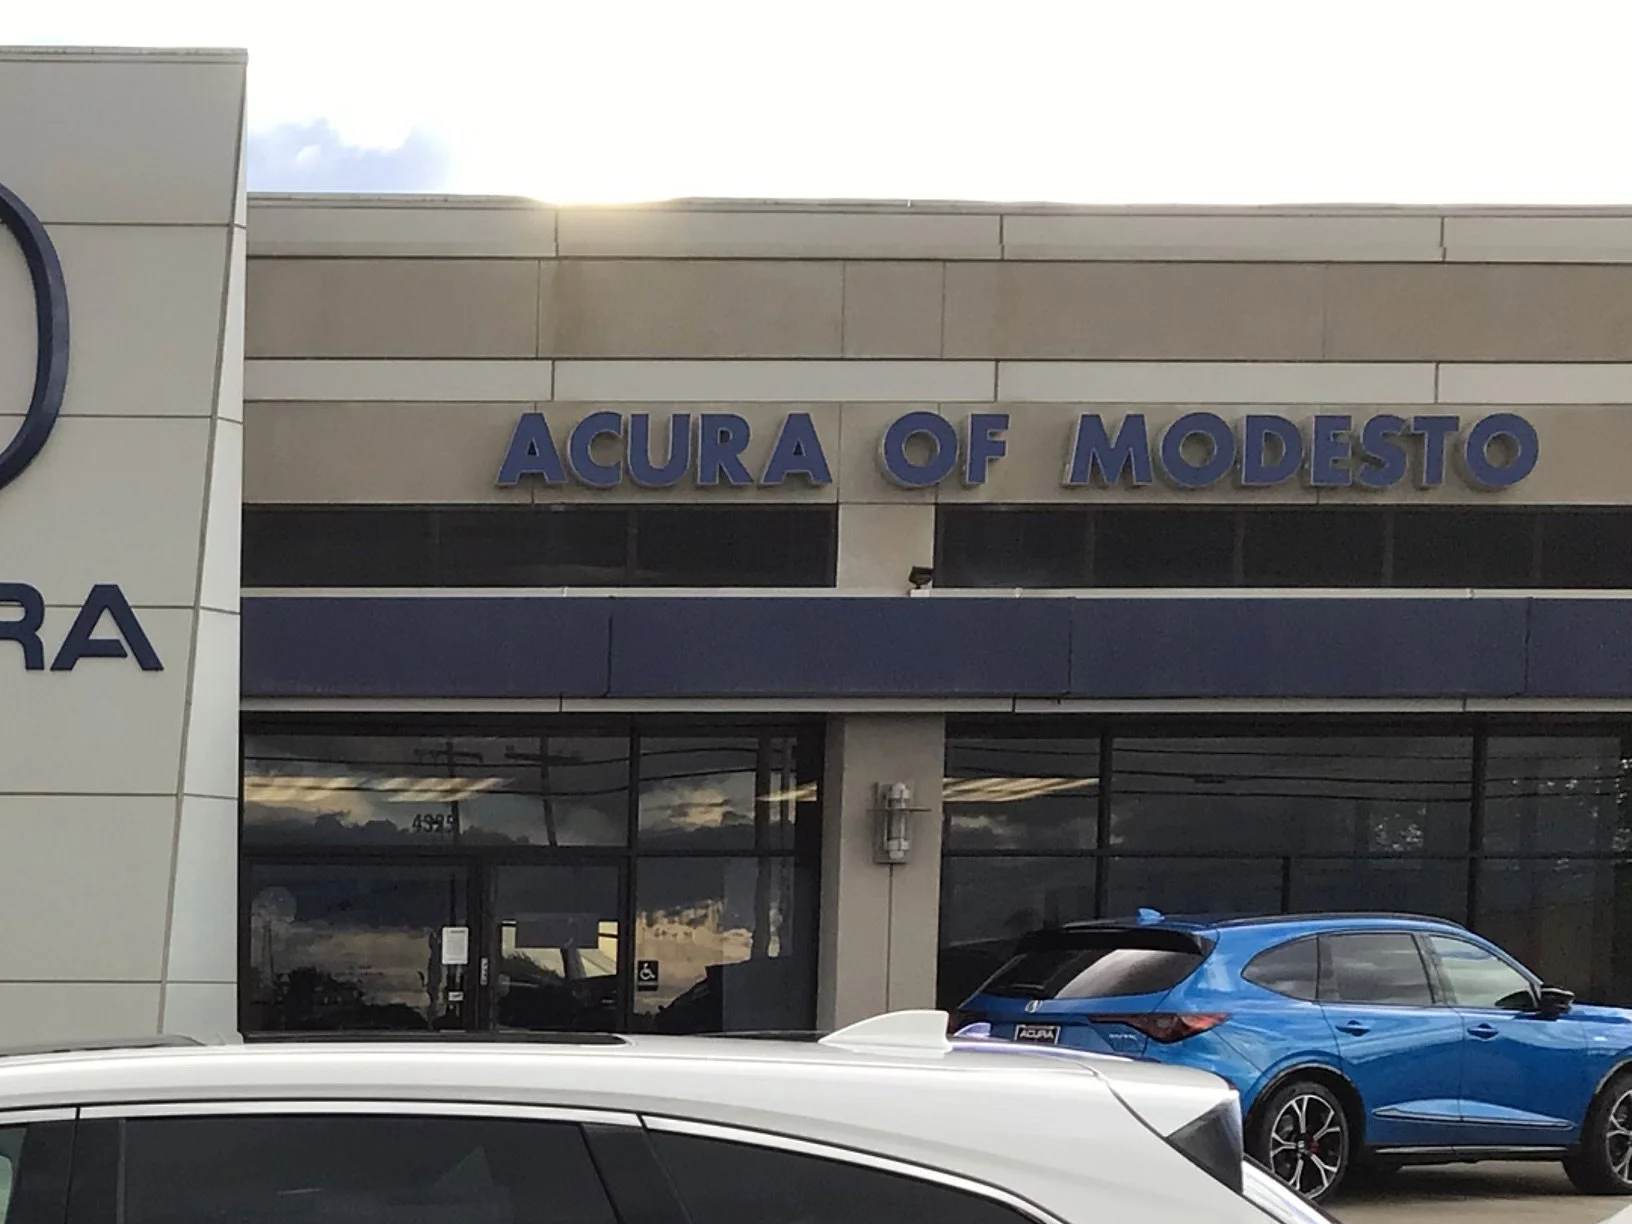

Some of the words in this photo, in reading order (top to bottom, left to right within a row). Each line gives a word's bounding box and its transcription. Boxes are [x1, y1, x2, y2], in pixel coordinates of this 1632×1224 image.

[495, 410, 832, 489] ACURA
[881, 411, 1010, 489] OF
[1064, 412, 1540, 489] MODESTO
[1019, 1029, 1055, 1040] ACURA
